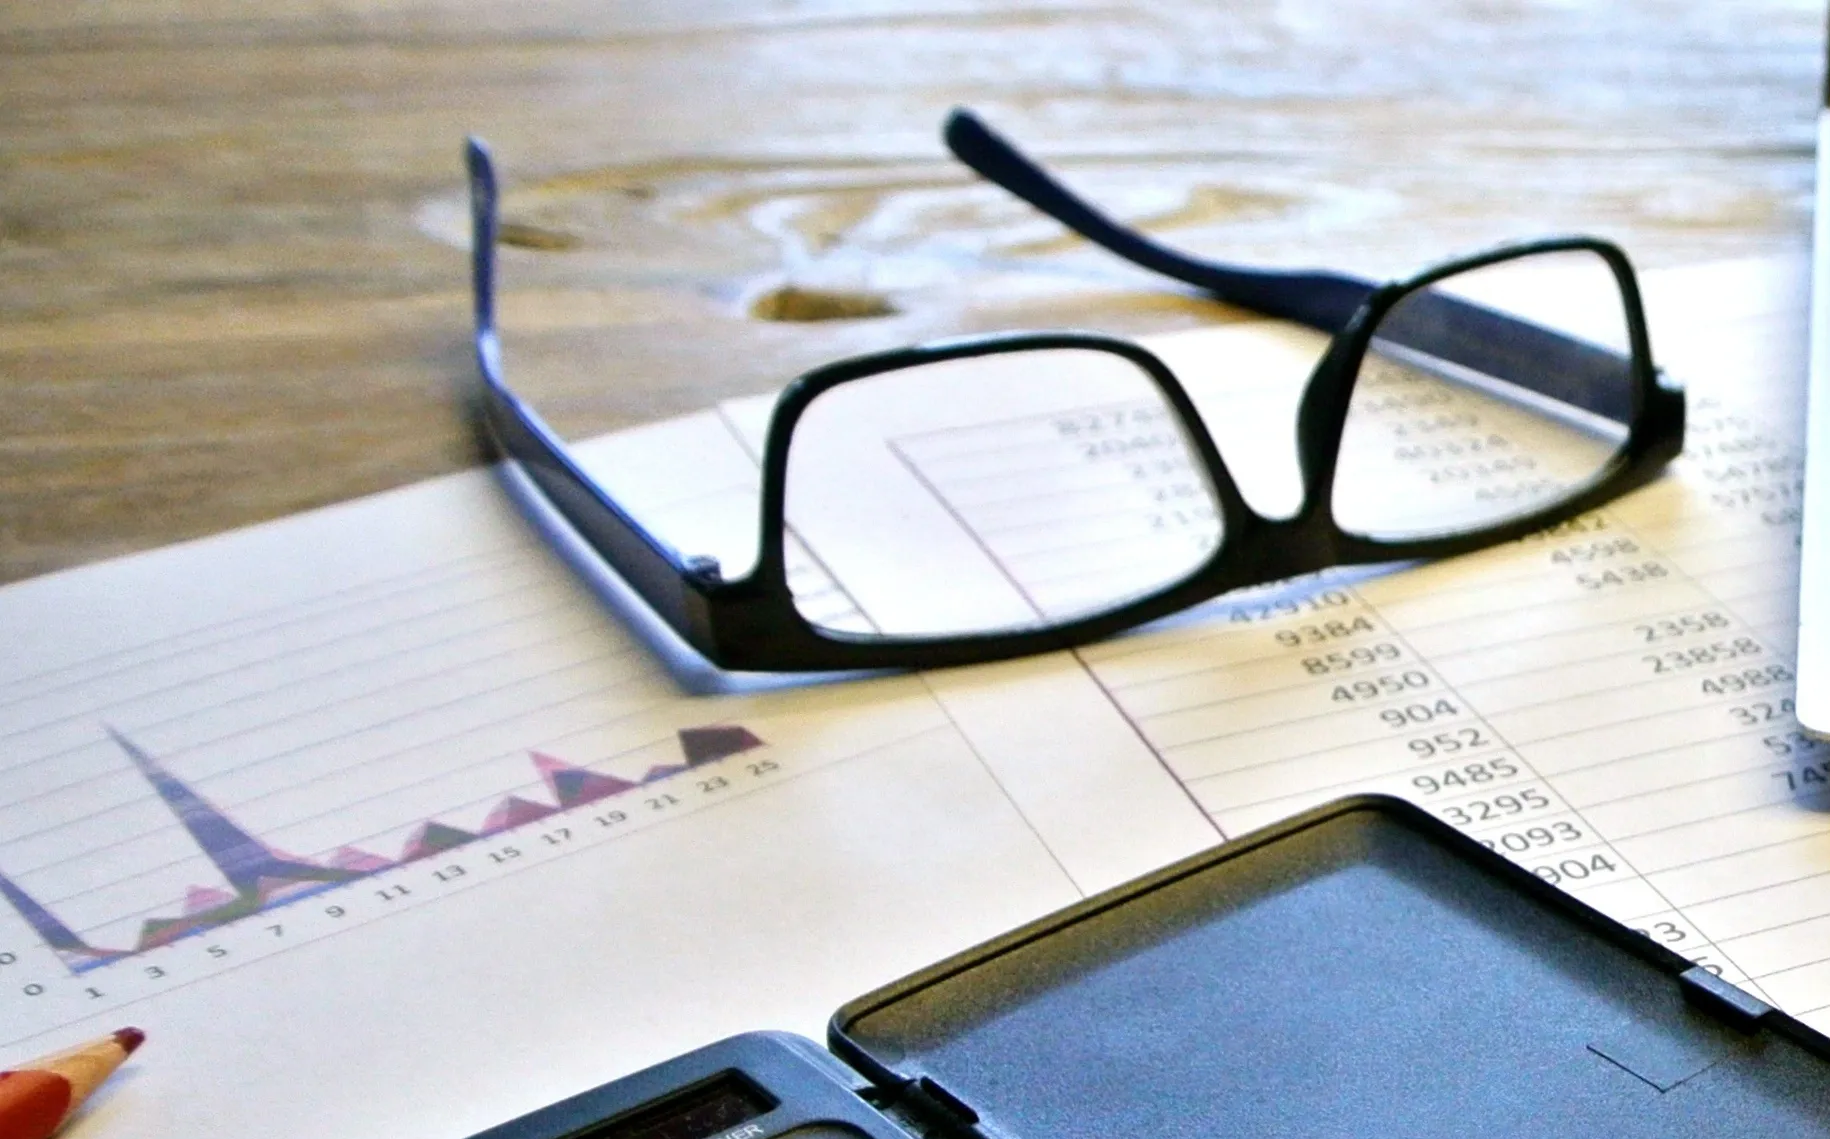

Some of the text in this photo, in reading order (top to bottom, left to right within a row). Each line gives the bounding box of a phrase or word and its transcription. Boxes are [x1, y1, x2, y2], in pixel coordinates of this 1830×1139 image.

[1275, 616, 1374, 647] 9384
[1633, 611, 1730, 642] 2358
[1300, 643, 1401, 675] 8599
[1641, 637, 1762, 674] 23858
[1331, 670, 1430, 702] 4950
[1702, 664, 1794, 695] 4988
[1379, 699, 1458, 728] 904
[1407, 728, 1490, 758] 952
[1412, 757, 1519, 796] 9485
[1442, 788, 1550, 827] 3295
[144, 965, 166, 981] 3
[206, 944, 228, 959] 5
[266, 923, 285, 938] 7
[324, 905, 347, 920] 9
[374, 884, 412, 902] 11
[432, 864, 468, 883] 13
[487, 845, 521, 864] 15
[540, 827, 574, 846] 17
[593, 809, 628, 828] 19
[696, 775, 730, 794] 23
[745, 758, 781, 777] 25
